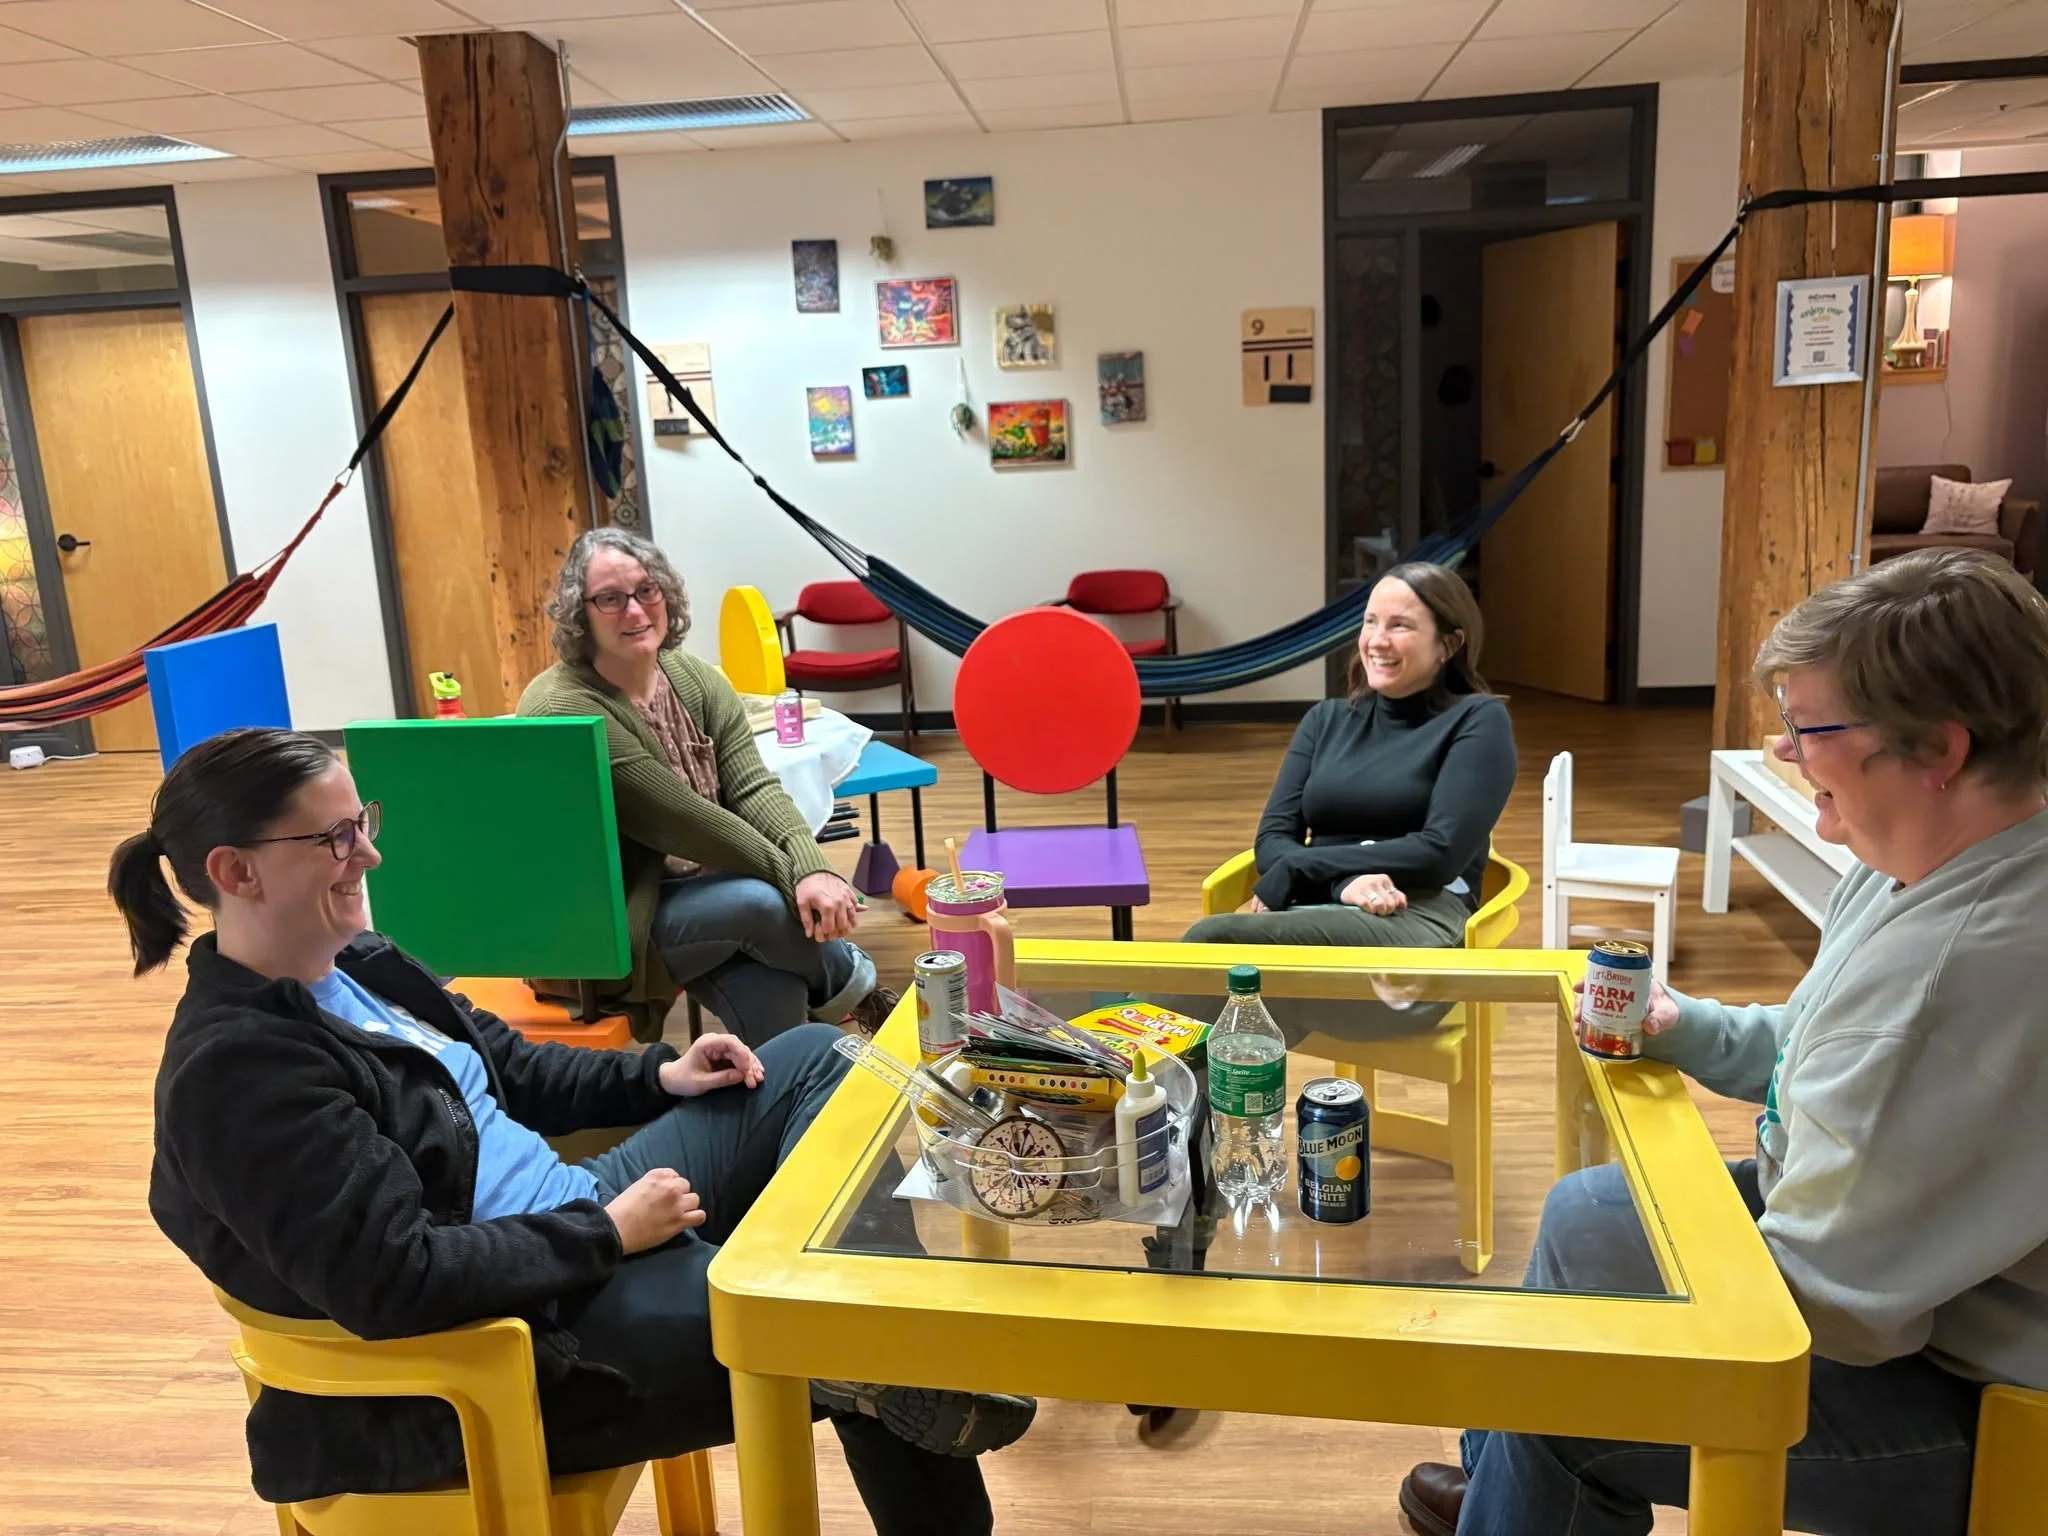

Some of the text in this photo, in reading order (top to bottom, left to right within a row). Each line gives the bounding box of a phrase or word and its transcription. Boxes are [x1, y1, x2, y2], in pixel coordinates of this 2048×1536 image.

[1251, 318, 1265, 336] 9
[1589, 983, 1635, 1003] FARM
[1593, 997, 1628, 1012] DAY
[1298, 1127, 1361, 1155] BLUE MOON
[1304, 1178, 1352, 1193] BELGIAN
[1308, 1188, 1346, 1202] WHITE
